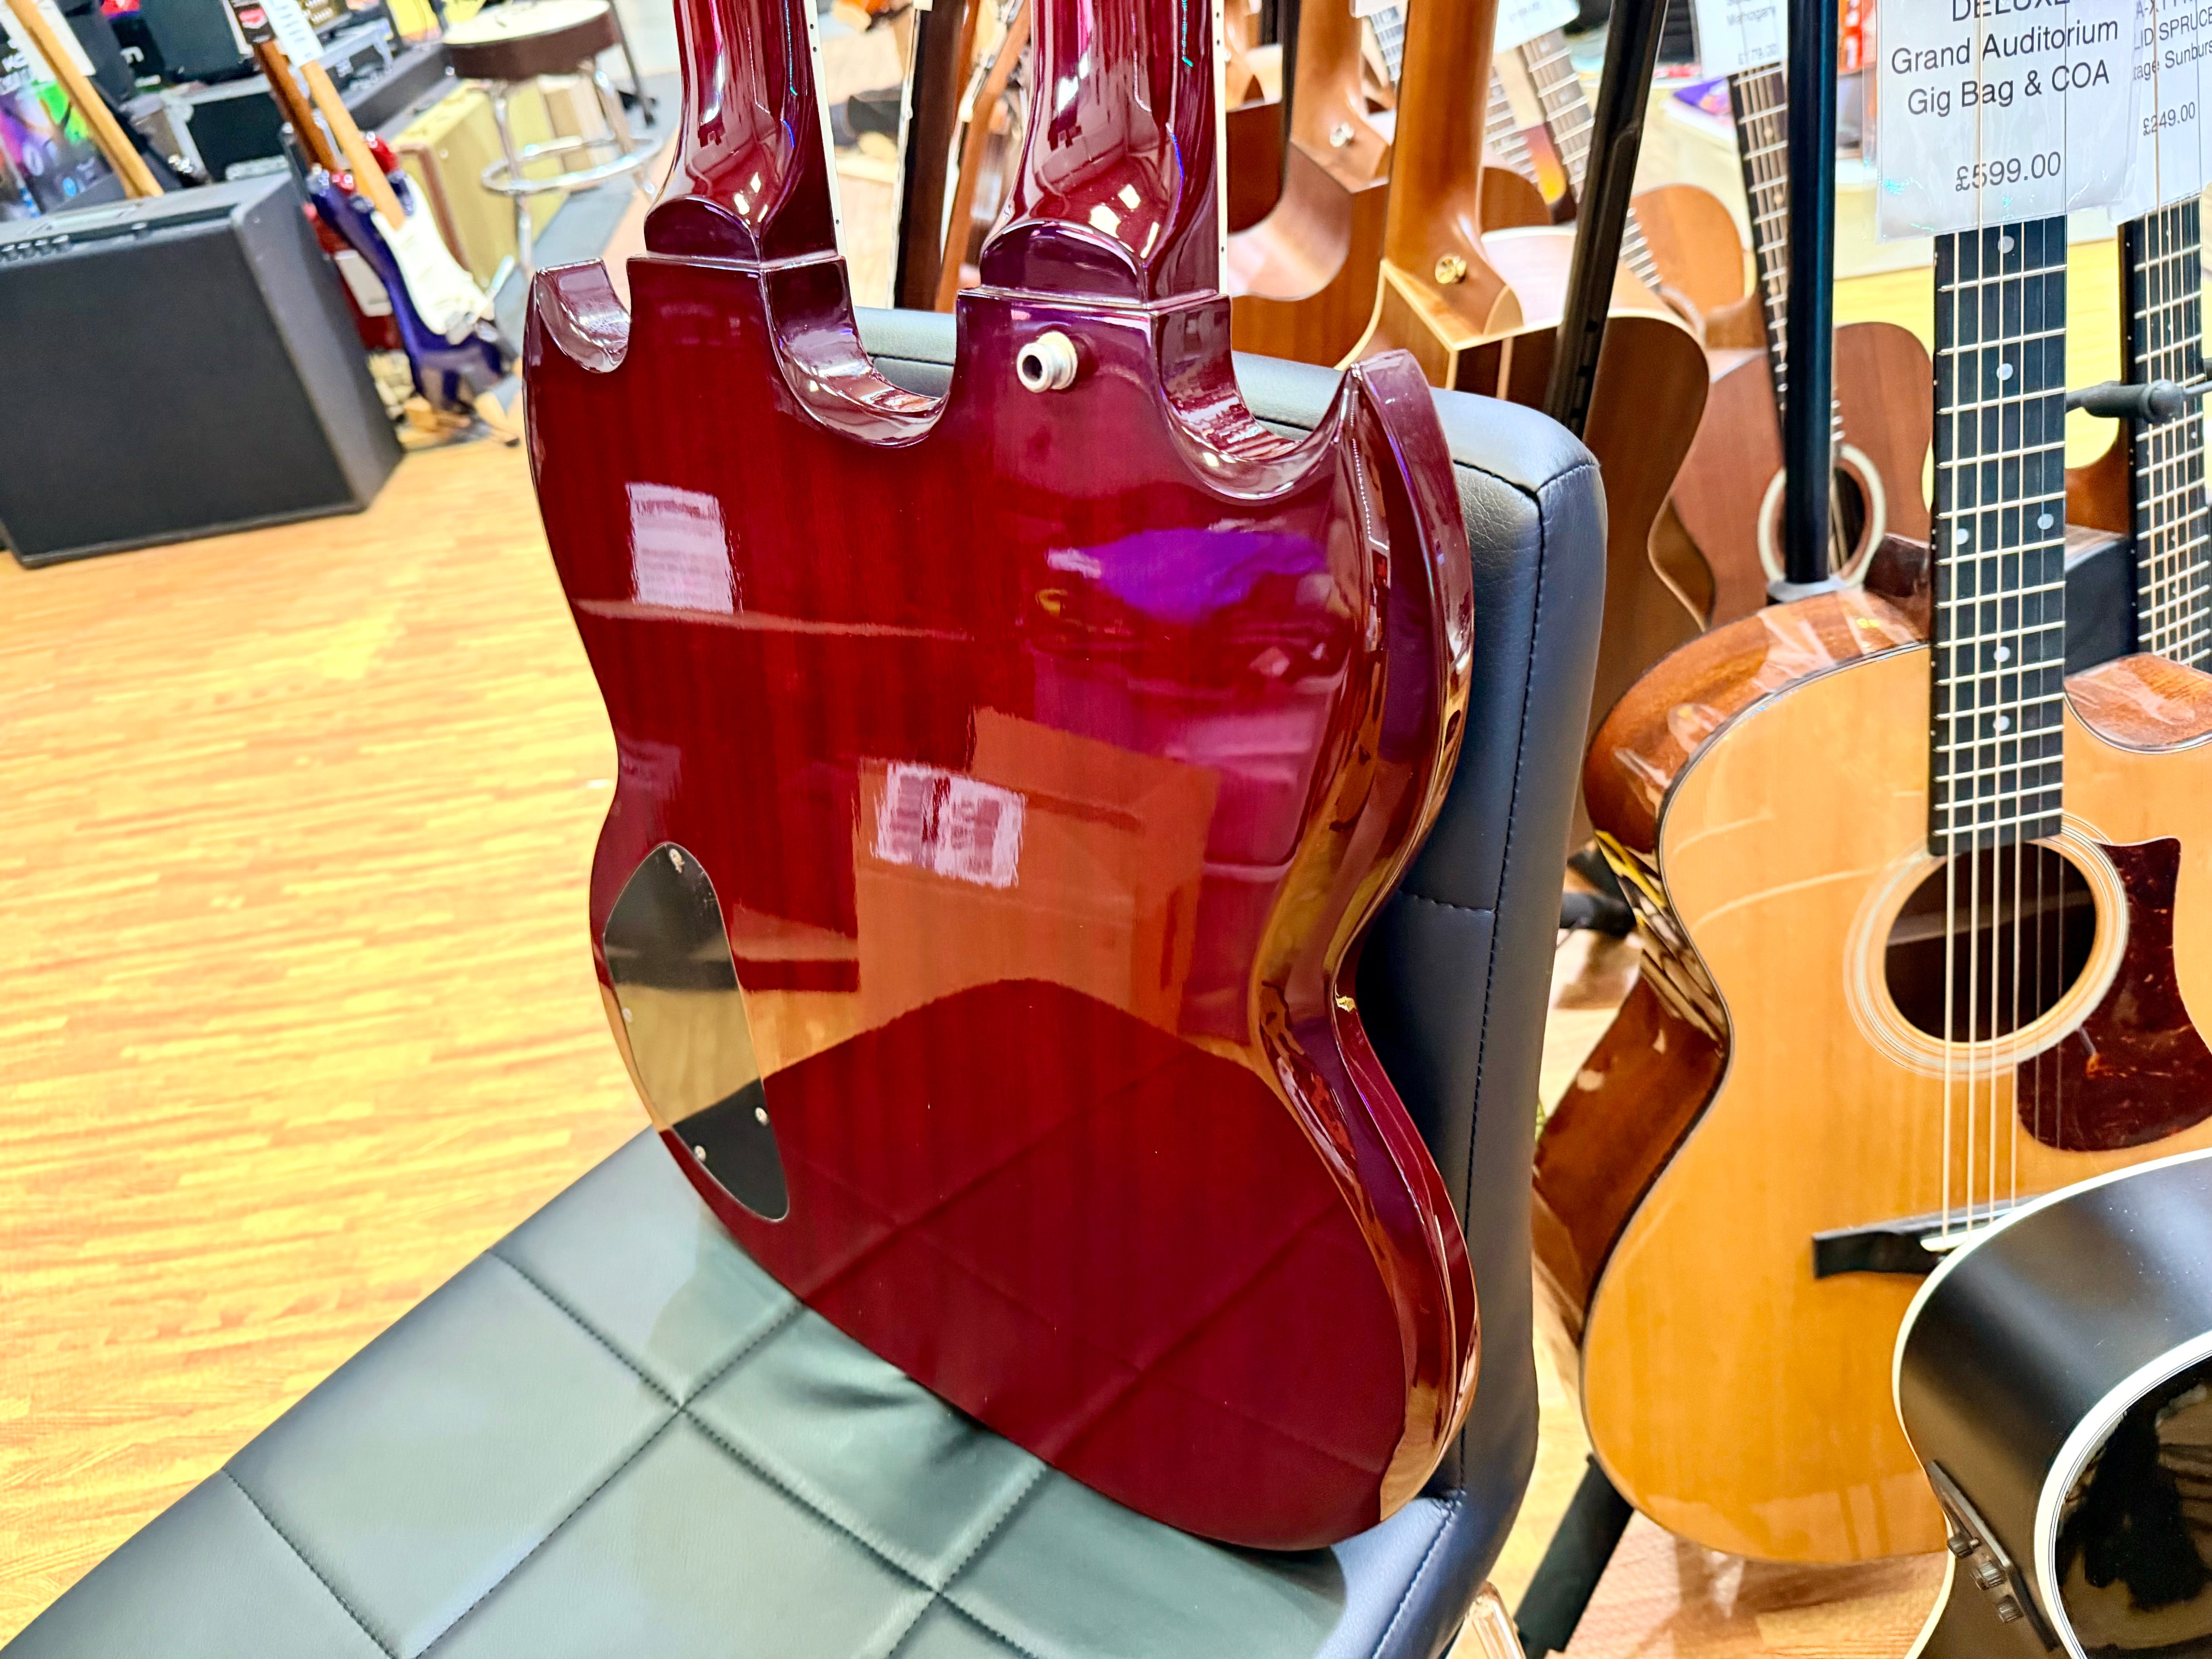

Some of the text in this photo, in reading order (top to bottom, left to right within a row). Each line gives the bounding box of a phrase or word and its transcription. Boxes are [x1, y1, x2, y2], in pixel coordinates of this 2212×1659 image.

[1953, 0, 2070, 22] DEL
[1891, 19, 2118, 74] Grand Auditorium
[1908, 59, 2109, 117] Gig Bag & COA
[2143, 101, 2196, 136] £249.00
[1955, 151, 2061, 192] £599.00
